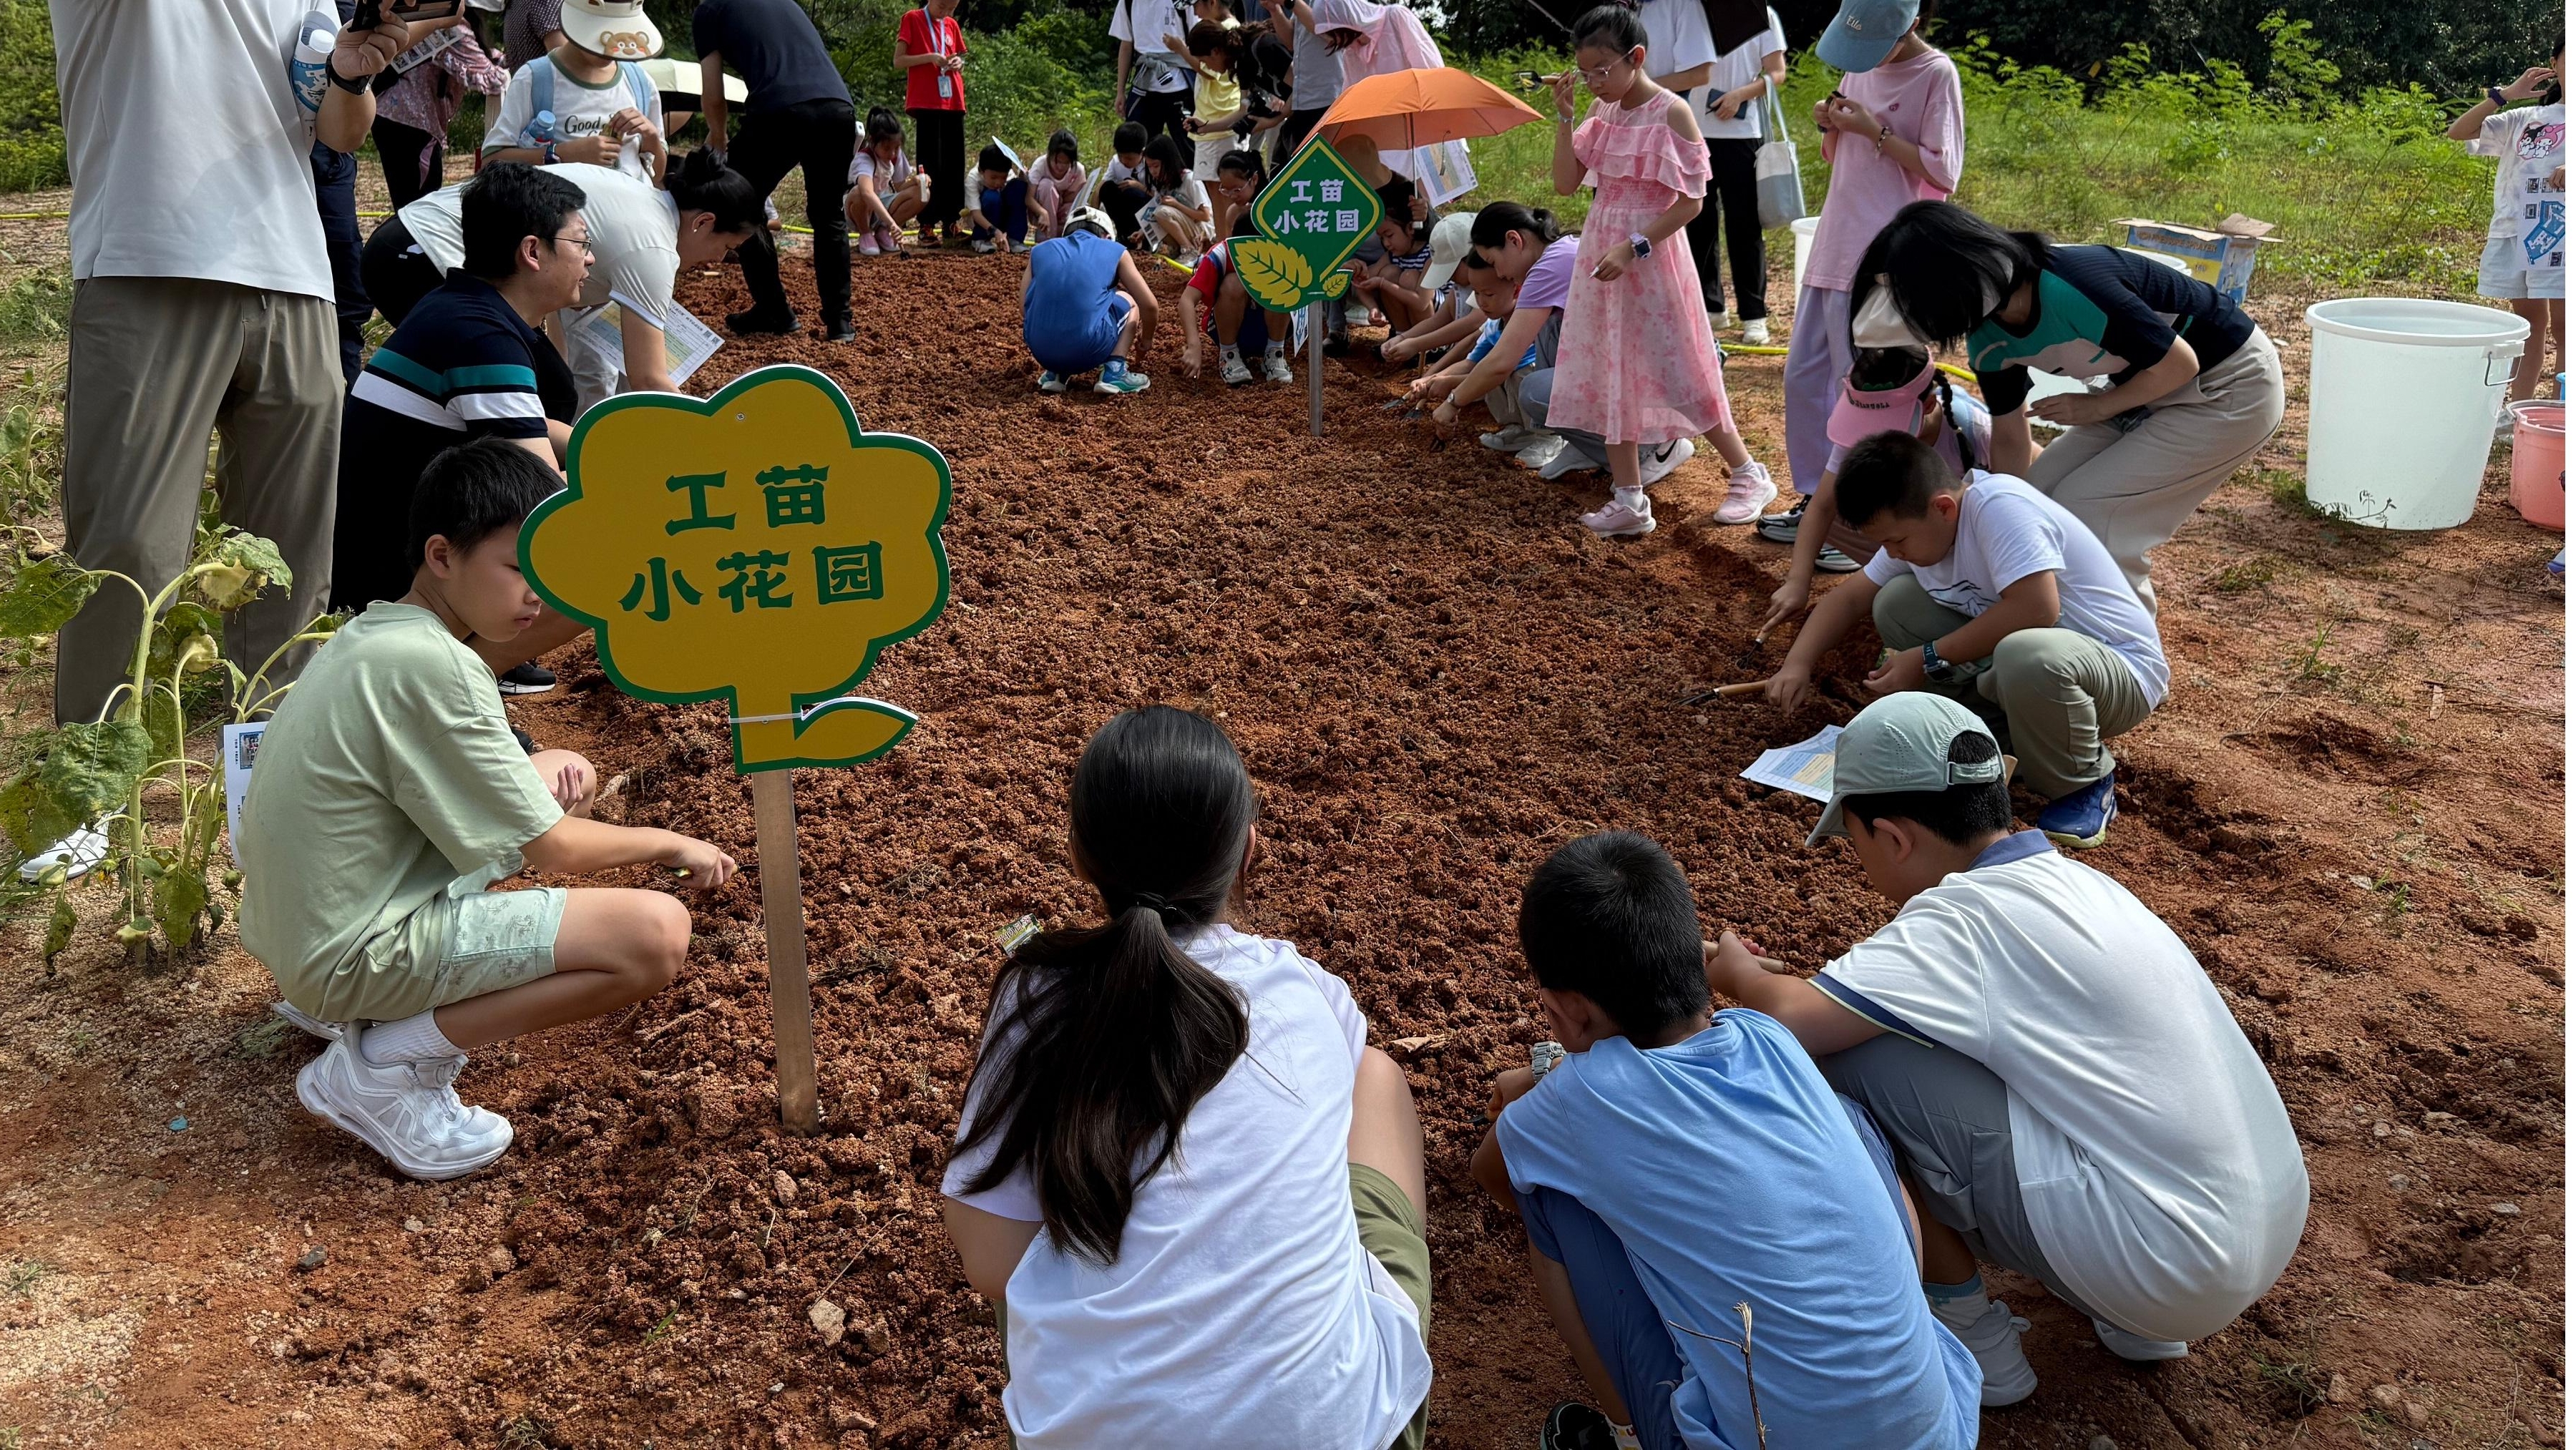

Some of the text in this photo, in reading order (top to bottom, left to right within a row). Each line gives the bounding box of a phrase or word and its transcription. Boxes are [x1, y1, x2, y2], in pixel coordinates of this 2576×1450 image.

[564, 114, 601, 134] Good
[1289, 179, 1344, 203] 工苗
[1273, 208, 1360, 235] 小花园
[665, 464, 830, 537] 工苗
[618, 540, 885, 622] 小花园
